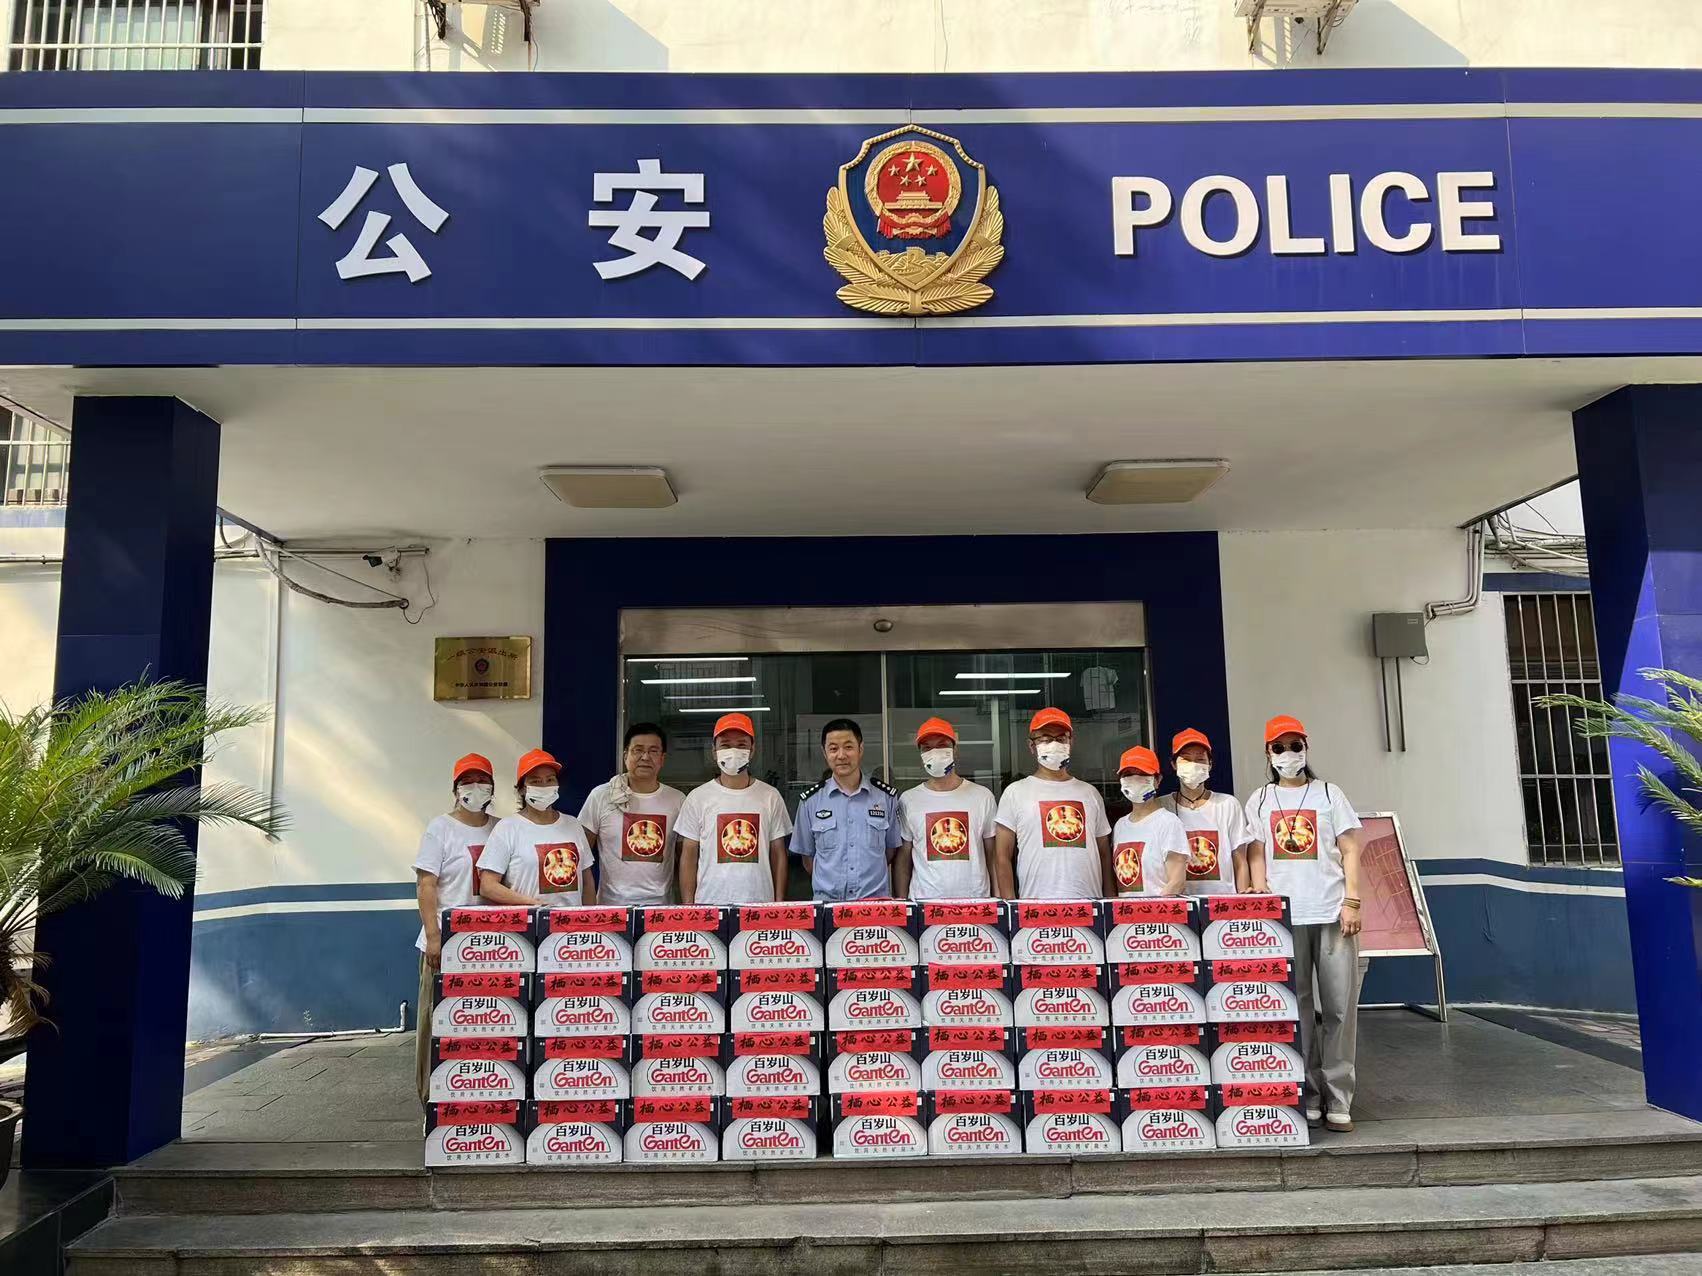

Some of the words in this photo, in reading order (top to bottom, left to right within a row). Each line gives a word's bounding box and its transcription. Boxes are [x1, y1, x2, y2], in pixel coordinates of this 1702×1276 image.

[317, 159, 710, 282] 公安
[1112, 171, 1500, 256] POLICE
[853, 928, 889, 940] 百岁山
[945, 926, 981, 938] 百岁山
[1039, 927, 1075, 939] 百岁山
[1134, 923, 1170, 935] 百岁山
[1229, 921, 1265, 933] 百岁山
[469, 934, 505, 946] 百岁山
[567, 933, 603, 946] 百岁山
[662, 931, 698, 944] 百岁山
[757, 930, 793, 941] 百岁山
[1125, 934, 1184, 951] Ganten
[1222, 932, 1278, 949] Ganten
[558, 945, 616, 962] Ganten
[653, 943, 710, 960] Ganten
[749, 940, 807, 957] Ganten
[845, 939, 901, 956] Ganten
[939, 937, 994, 954] Ganten
[1030, 938, 1088, 955] Ganten
[462, 946, 519, 962] Ganten
[856, 990, 892, 1003] 百岁山
[948, 990, 984, 1001] 百岁山
[1042, 988, 1078, 999] 百岁山
[1139, 986, 1175, 998] 百岁山
[1232, 983, 1268, 995] 百岁山
[462, 997, 498, 1009] 百岁山
[564, 997, 600, 1009] 百岁山
[660, 995, 696, 1008] 百岁山
[759, 993, 795, 1007] 百岁山
[1034, 998, 1092, 1015] Ganten
[1132, 997, 1187, 1014] Ganten
[1224, 994, 1282, 1011] Ganten
[556, 1008, 615, 1025] Ganten
[653, 1007, 707, 1024] Ganten
[751, 1006, 808, 1023] Ganten
[847, 1002, 905, 1019] Ganten
[940, 1000, 997, 1017] Ganten
[454, 1009, 512, 1025] Ganten
[949, 1051, 985, 1064] 百岁山
[1047, 1050, 1083, 1063] 百岁山
[1145, 1047, 1181, 1059] 百岁山
[1238, 1044, 1274, 1056] 百岁山
[563, 1059, 599, 1073] 百岁山
[659, 1058, 695, 1069] 百岁山
[756, 1056, 792, 1070] 百岁山
[856, 1052, 892, 1066] 百岁山
[1139, 1059, 1194, 1075] Ganten
[1231, 1055, 1288, 1072] Ganten
[459, 1061, 495, 1075] 百岁山
[847, 1065, 907, 1082] Ganten
[941, 1063, 998, 1080] Ganten
[1039, 1062, 1095, 1079] Ganten
[451, 1074, 511, 1091] Ganten
[554, 1072, 613, 1089] Ganten
[652, 1068, 709, 1085] Ganten
[747, 1069, 804, 1086] Ganten
[956, 1115, 992, 1128] 百岁山
[1054, 1113, 1090, 1127] 百岁山
[1149, 1111, 1185, 1124] 百岁山
[1243, 1108, 1279, 1121] 百岁山
[455, 1125, 491, 1137] 百岁山
[556, 1123, 592, 1137] 百岁山
[652, 1123, 688, 1135] 百岁山
[749, 1120, 785, 1133] 百岁山
[861, 1118, 897, 1131] 百岁山
[1144, 1123, 1199, 1140] Ganten
[1235, 1120, 1293, 1137] Ganten
[644, 1134, 701, 1151] Ganten
[743, 1132, 800, 1149] Ganten
[853, 1130, 911, 1147] Ganten
[946, 1127, 1004, 1144] Ganten
[1045, 1127, 1104, 1144] Ganten
[445, 1136, 507, 1153] Ganten
[547, 1136, 607, 1153] Ganten
